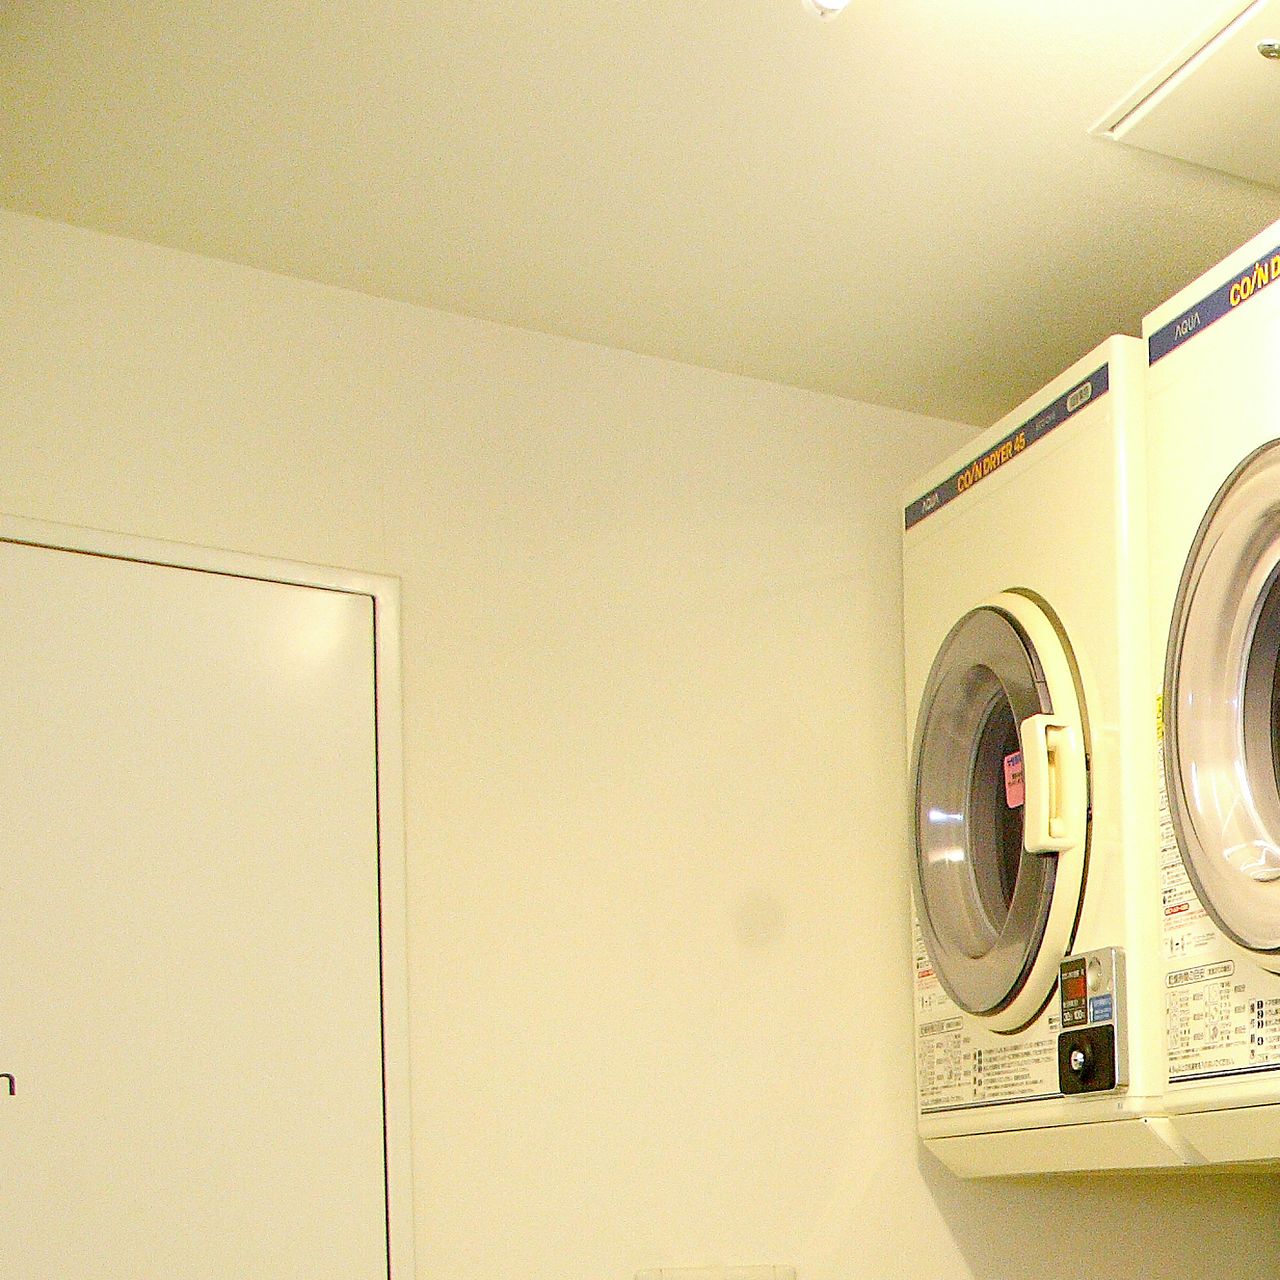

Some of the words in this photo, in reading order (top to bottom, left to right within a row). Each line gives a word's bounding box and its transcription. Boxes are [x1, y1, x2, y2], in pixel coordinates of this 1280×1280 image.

[1175, 312, 1200, 341] AQUA
[1229, 262, 1269, 308] COIN
[983, 440, 1013, 476] DRYER
[1013, 432, 1026, 453] 45
